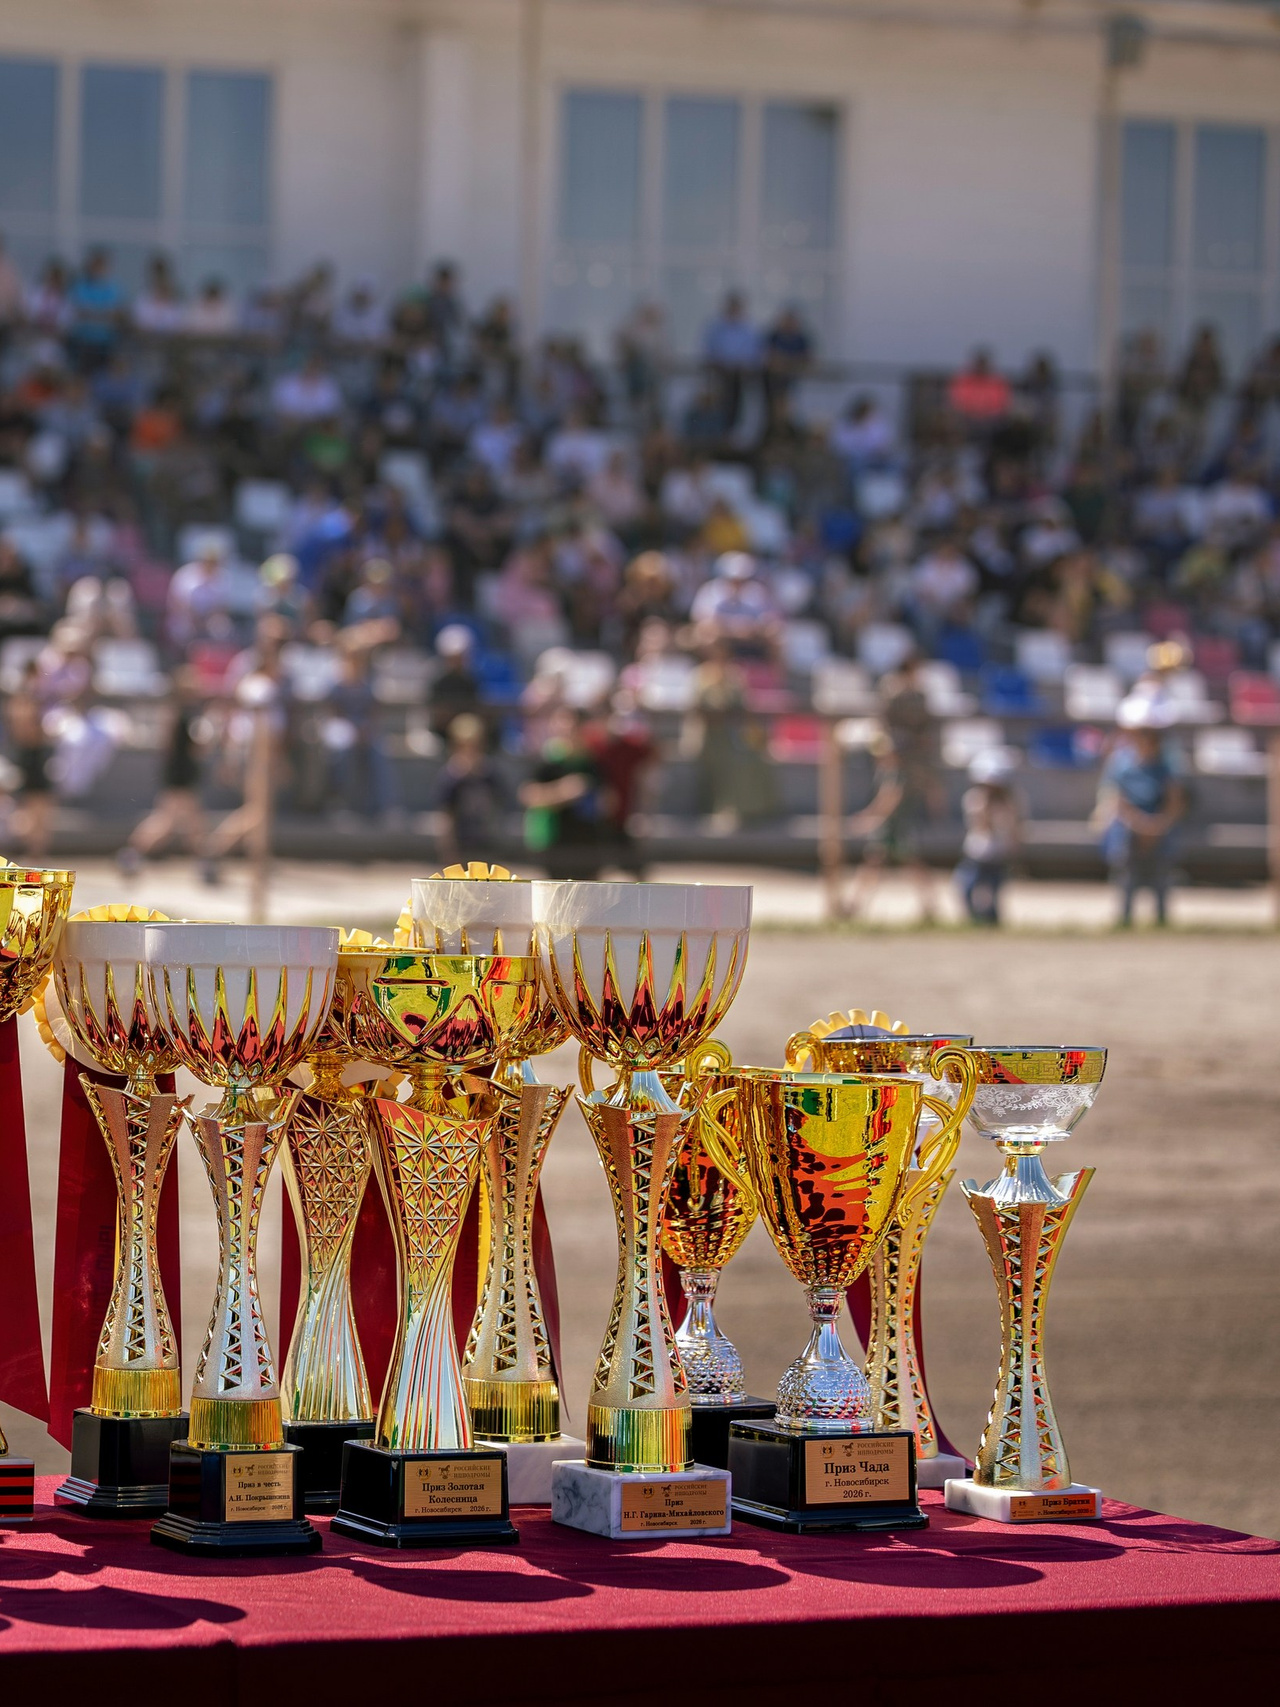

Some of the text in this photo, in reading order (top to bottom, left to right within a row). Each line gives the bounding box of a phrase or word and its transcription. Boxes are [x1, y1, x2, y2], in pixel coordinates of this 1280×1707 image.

[454, 1464, 492, 1472] РОССИЙСКИЕ
[824, 1461, 890, 1476] Приз Чада
[422, 1482, 485, 1492] Приз Золотая
[825, 1478, 890, 1488] г. Новосибирск
[428, 1494, 478, 1504] Колесница
[842, 1490, 864, 1498] 2026
[664, 1498, 684, 1508] Приз
[1042, 1498, 1062, 1507] Приз
[421, 1506, 463, 1514] Новосибирск
[640, 1509, 724, 1520] Гарина-Михайловского
